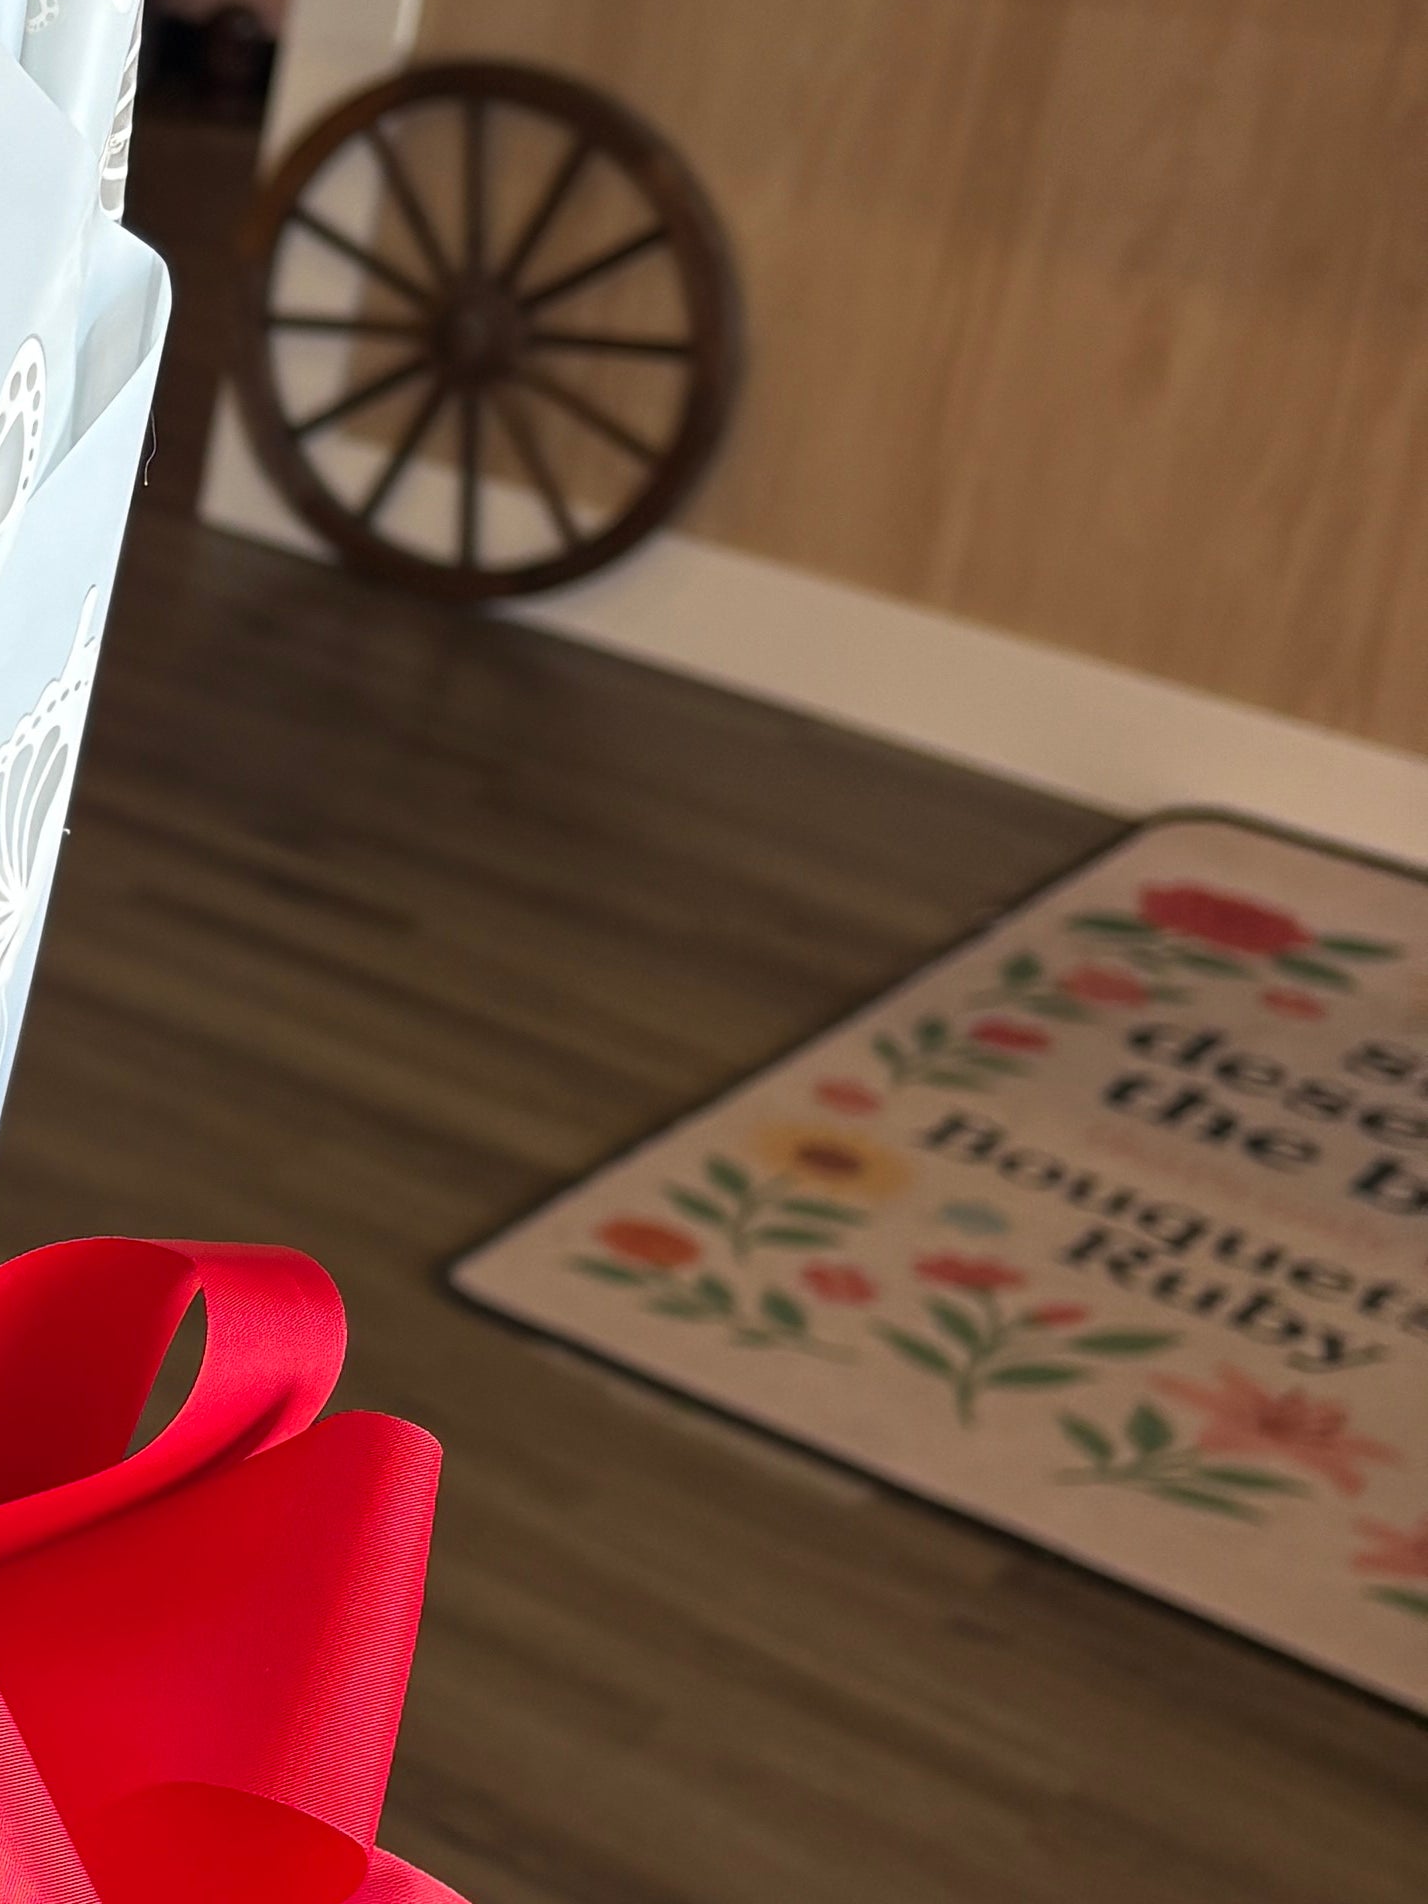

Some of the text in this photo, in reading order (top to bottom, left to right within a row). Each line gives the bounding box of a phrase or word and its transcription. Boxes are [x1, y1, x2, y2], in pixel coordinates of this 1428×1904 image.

[1101, 1069, 1324, 1173] the
[1128, 1022, 1428, 1149] dese
[1062, 1224, 1386, 1373] Ruby
